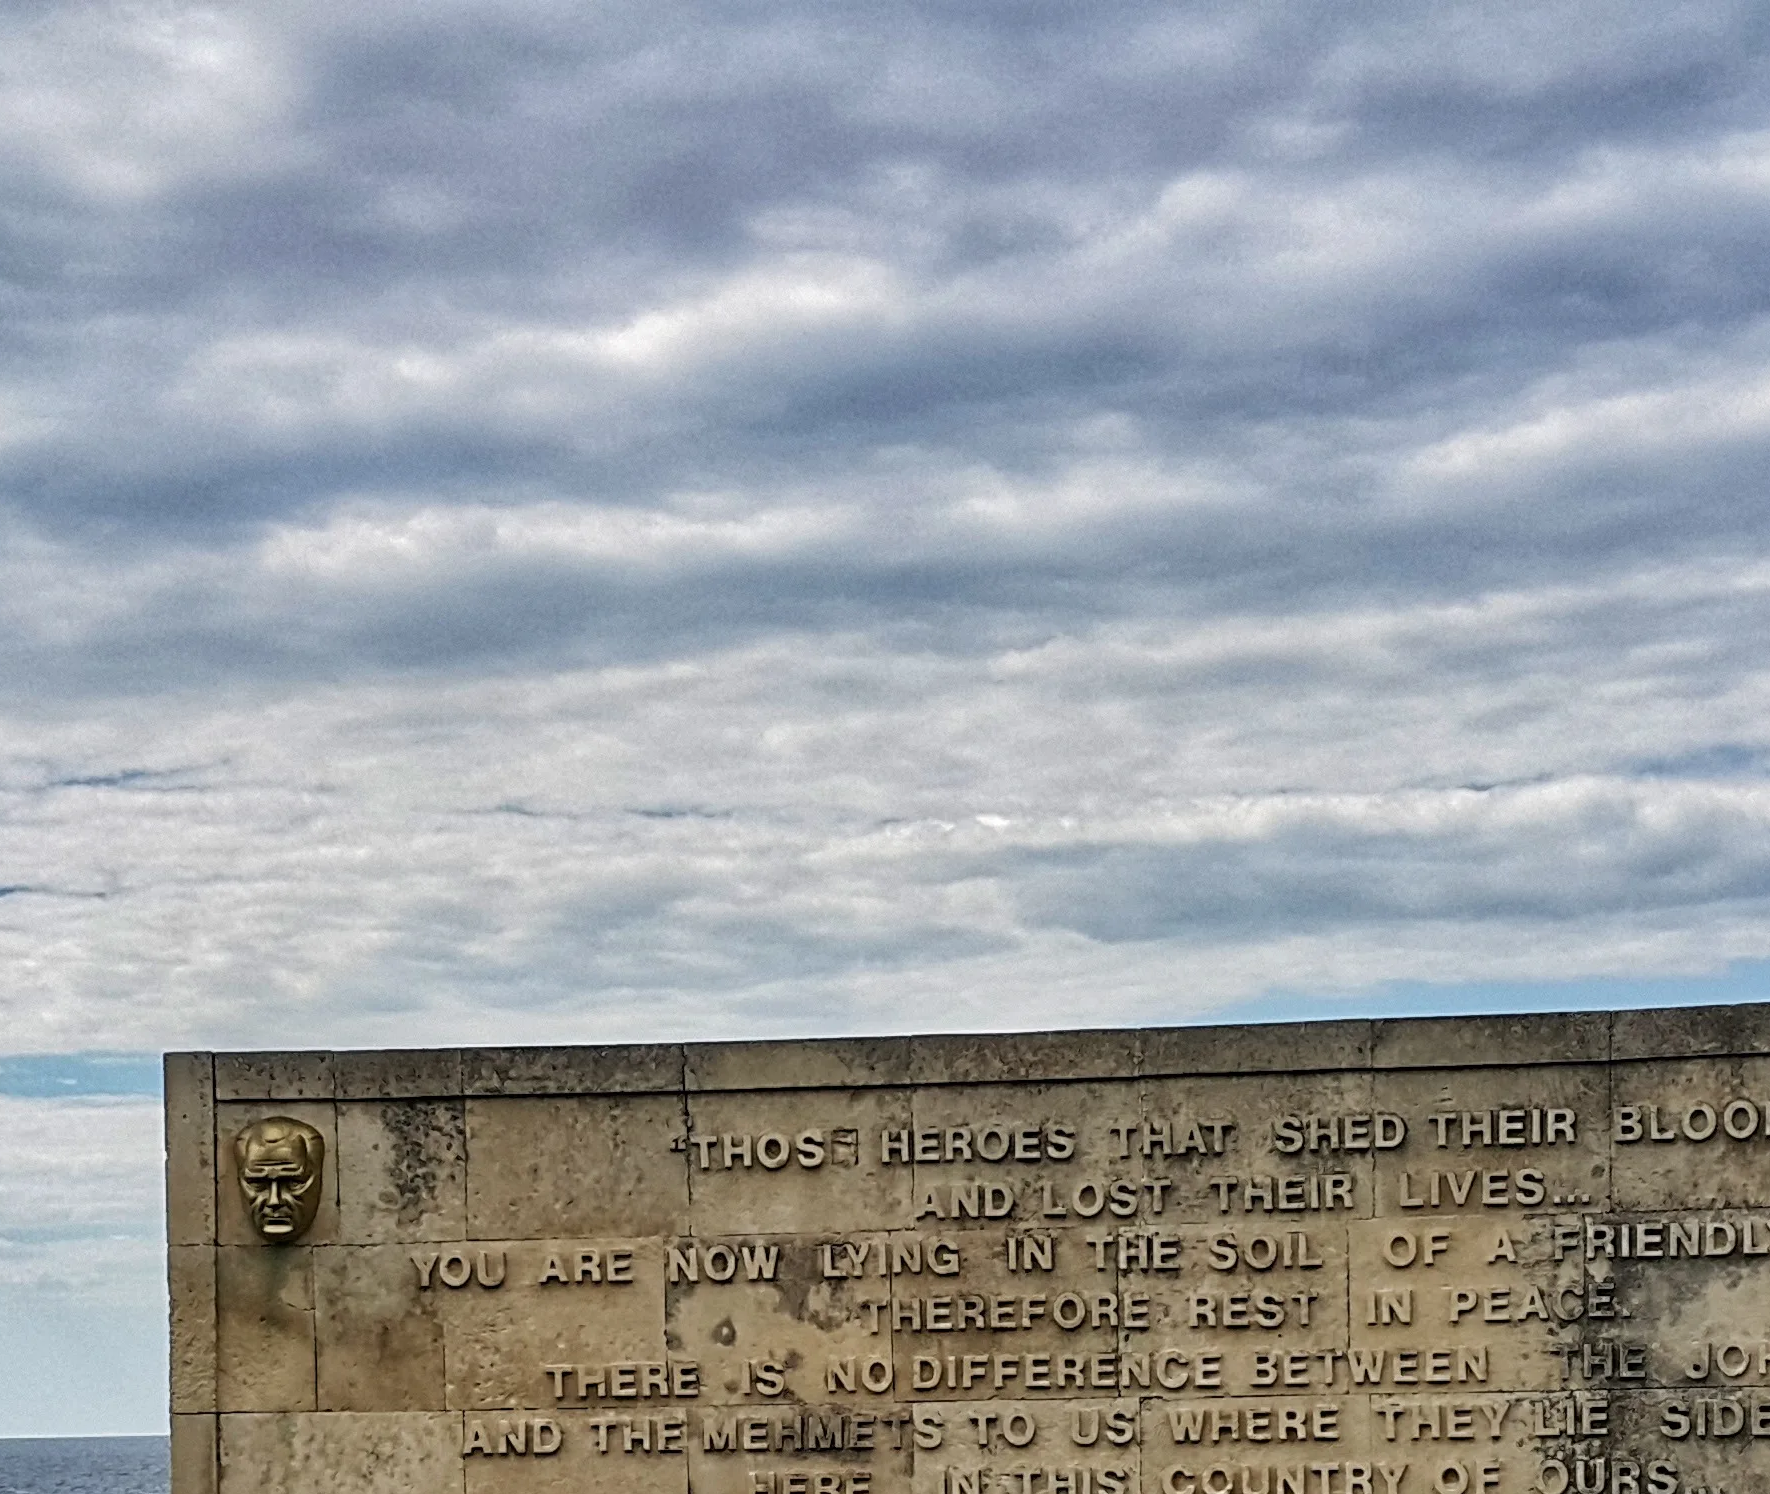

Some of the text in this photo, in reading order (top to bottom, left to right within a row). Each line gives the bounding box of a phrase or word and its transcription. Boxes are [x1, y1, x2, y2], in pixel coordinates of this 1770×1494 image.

[670, 1128, 859, 1169] “THOS
[880, 1124, 1075, 1166] HEROES
[1110, 1120, 1232, 1156] THAT
[1274, 1113, 1406, 1152] SHED
[1429, 1107, 1577, 1147] THEIR
[916, 1168, 1592, 1219] AND LOST THEIR LIVES...
[410, 1250, 507, 1289] YOU
[538, 1247, 633, 1284] ARE
[667, 1243, 780, 1283] NOW
[821, 1238, 961, 1276] LYING
[1007, 1236, 1055, 1271] IN
[1086, 1232, 1182, 1270] THE
[1207, 1231, 1323, 1271] SOIL
[1382, 1230, 1453, 1267] OF
[1486, 1228, 1519, 1264] A
[865, 1292, 1151, 1336] THEREFORE
[1188, 1287, 1318, 1328] REST
[1367, 1288, 1413, 1326] IN
[545, 1362, 699, 1399] THERE
[742, 1359, 785, 1397] IS
[827, 1355, 894, 1394] NO
[912, 1349, 1224, 1391] DIFFERENCE
[1248, 1345, 1489, 1387] BETWEEN
[1548, 1341, 1646, 1379] THE
[463, 1418, 562, 1455] AND
[590, 1415, 684, 1453] THE
[703, 1410, 942, 1453] MEHMETS
[969, 1409, 1035, 1448] TO
[1072, 1407, 1135, 1445] US
[1168, 1405, 1341, 1443] WHERE
[1377, 1400, 1510, 1441] THEY
[1534, 1398, 1609, 1437] LIE
